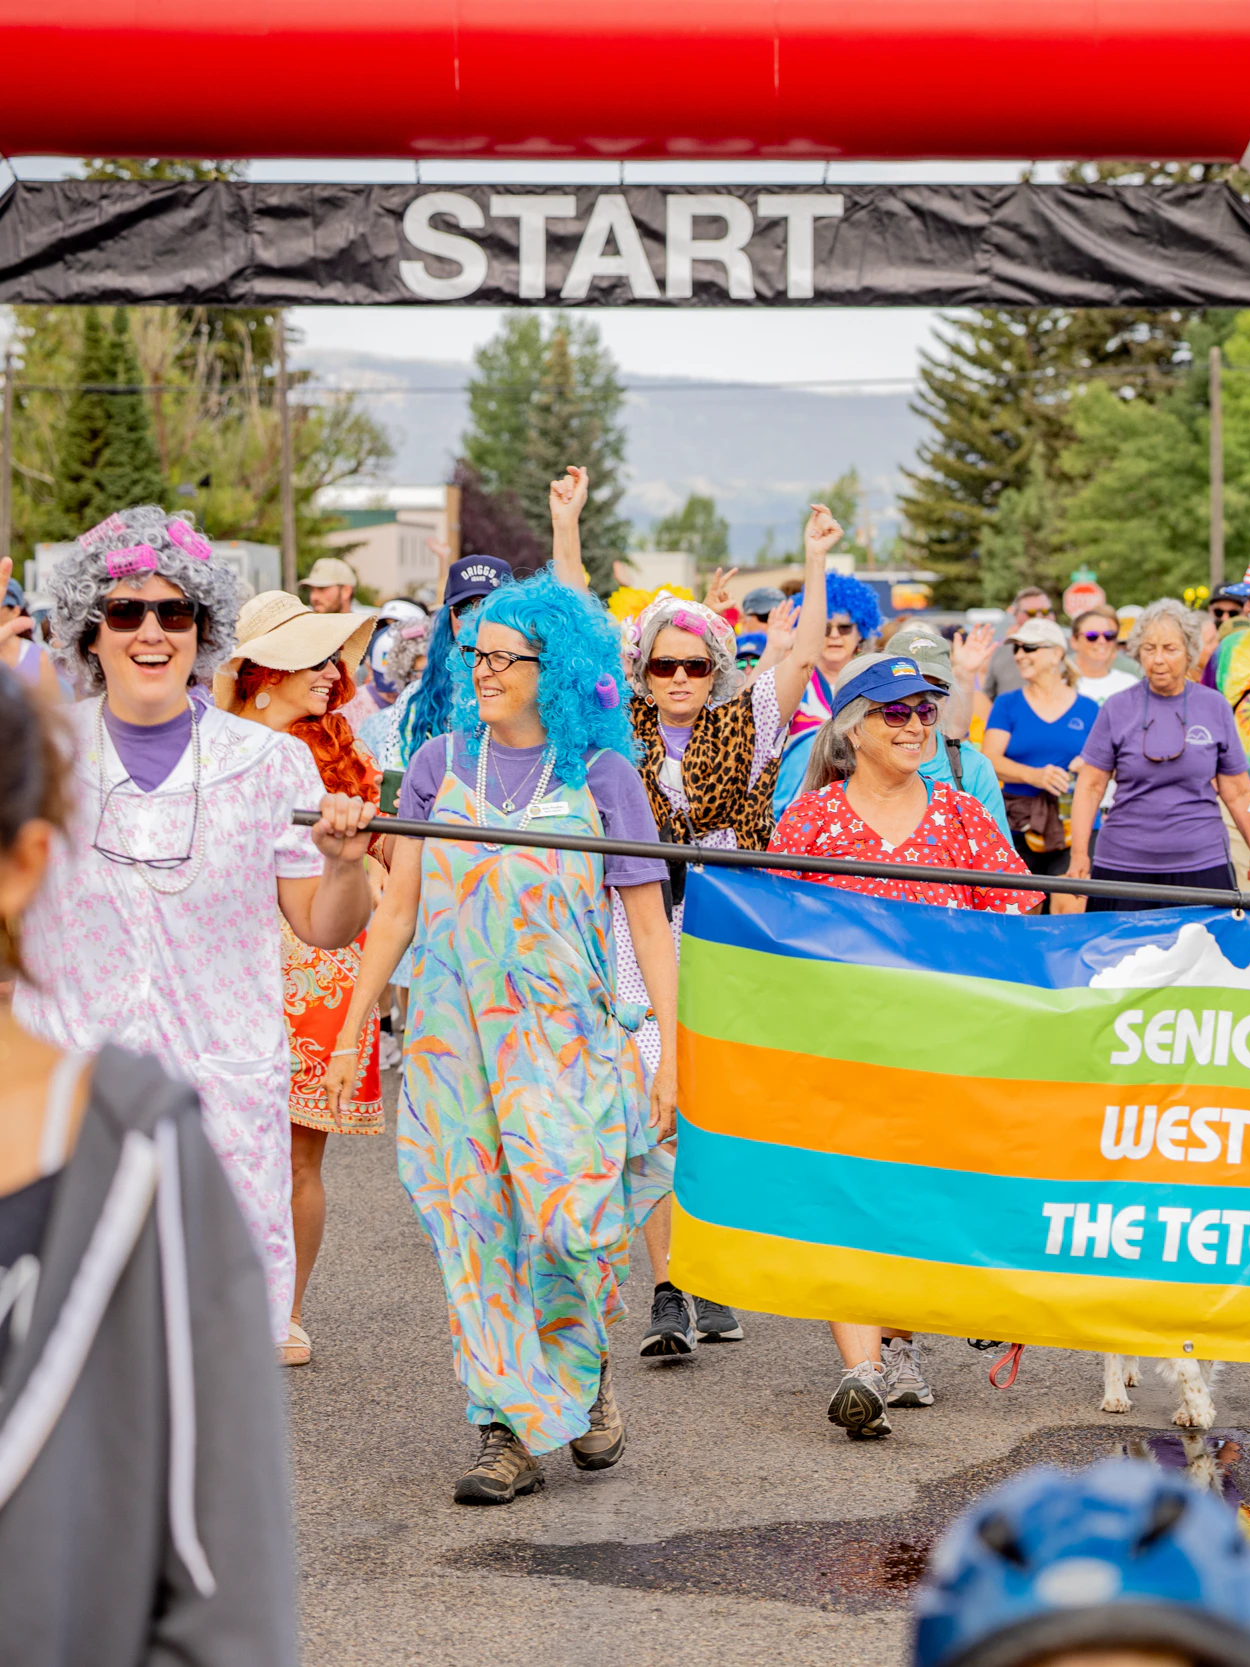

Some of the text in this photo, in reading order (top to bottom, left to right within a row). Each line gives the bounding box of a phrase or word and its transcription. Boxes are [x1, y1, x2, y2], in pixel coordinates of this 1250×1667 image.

[399, 191, 845, 300] START
[460, 564, 497, 581] DRIGGS
[1042, 1202, 1145, 1260] THE
